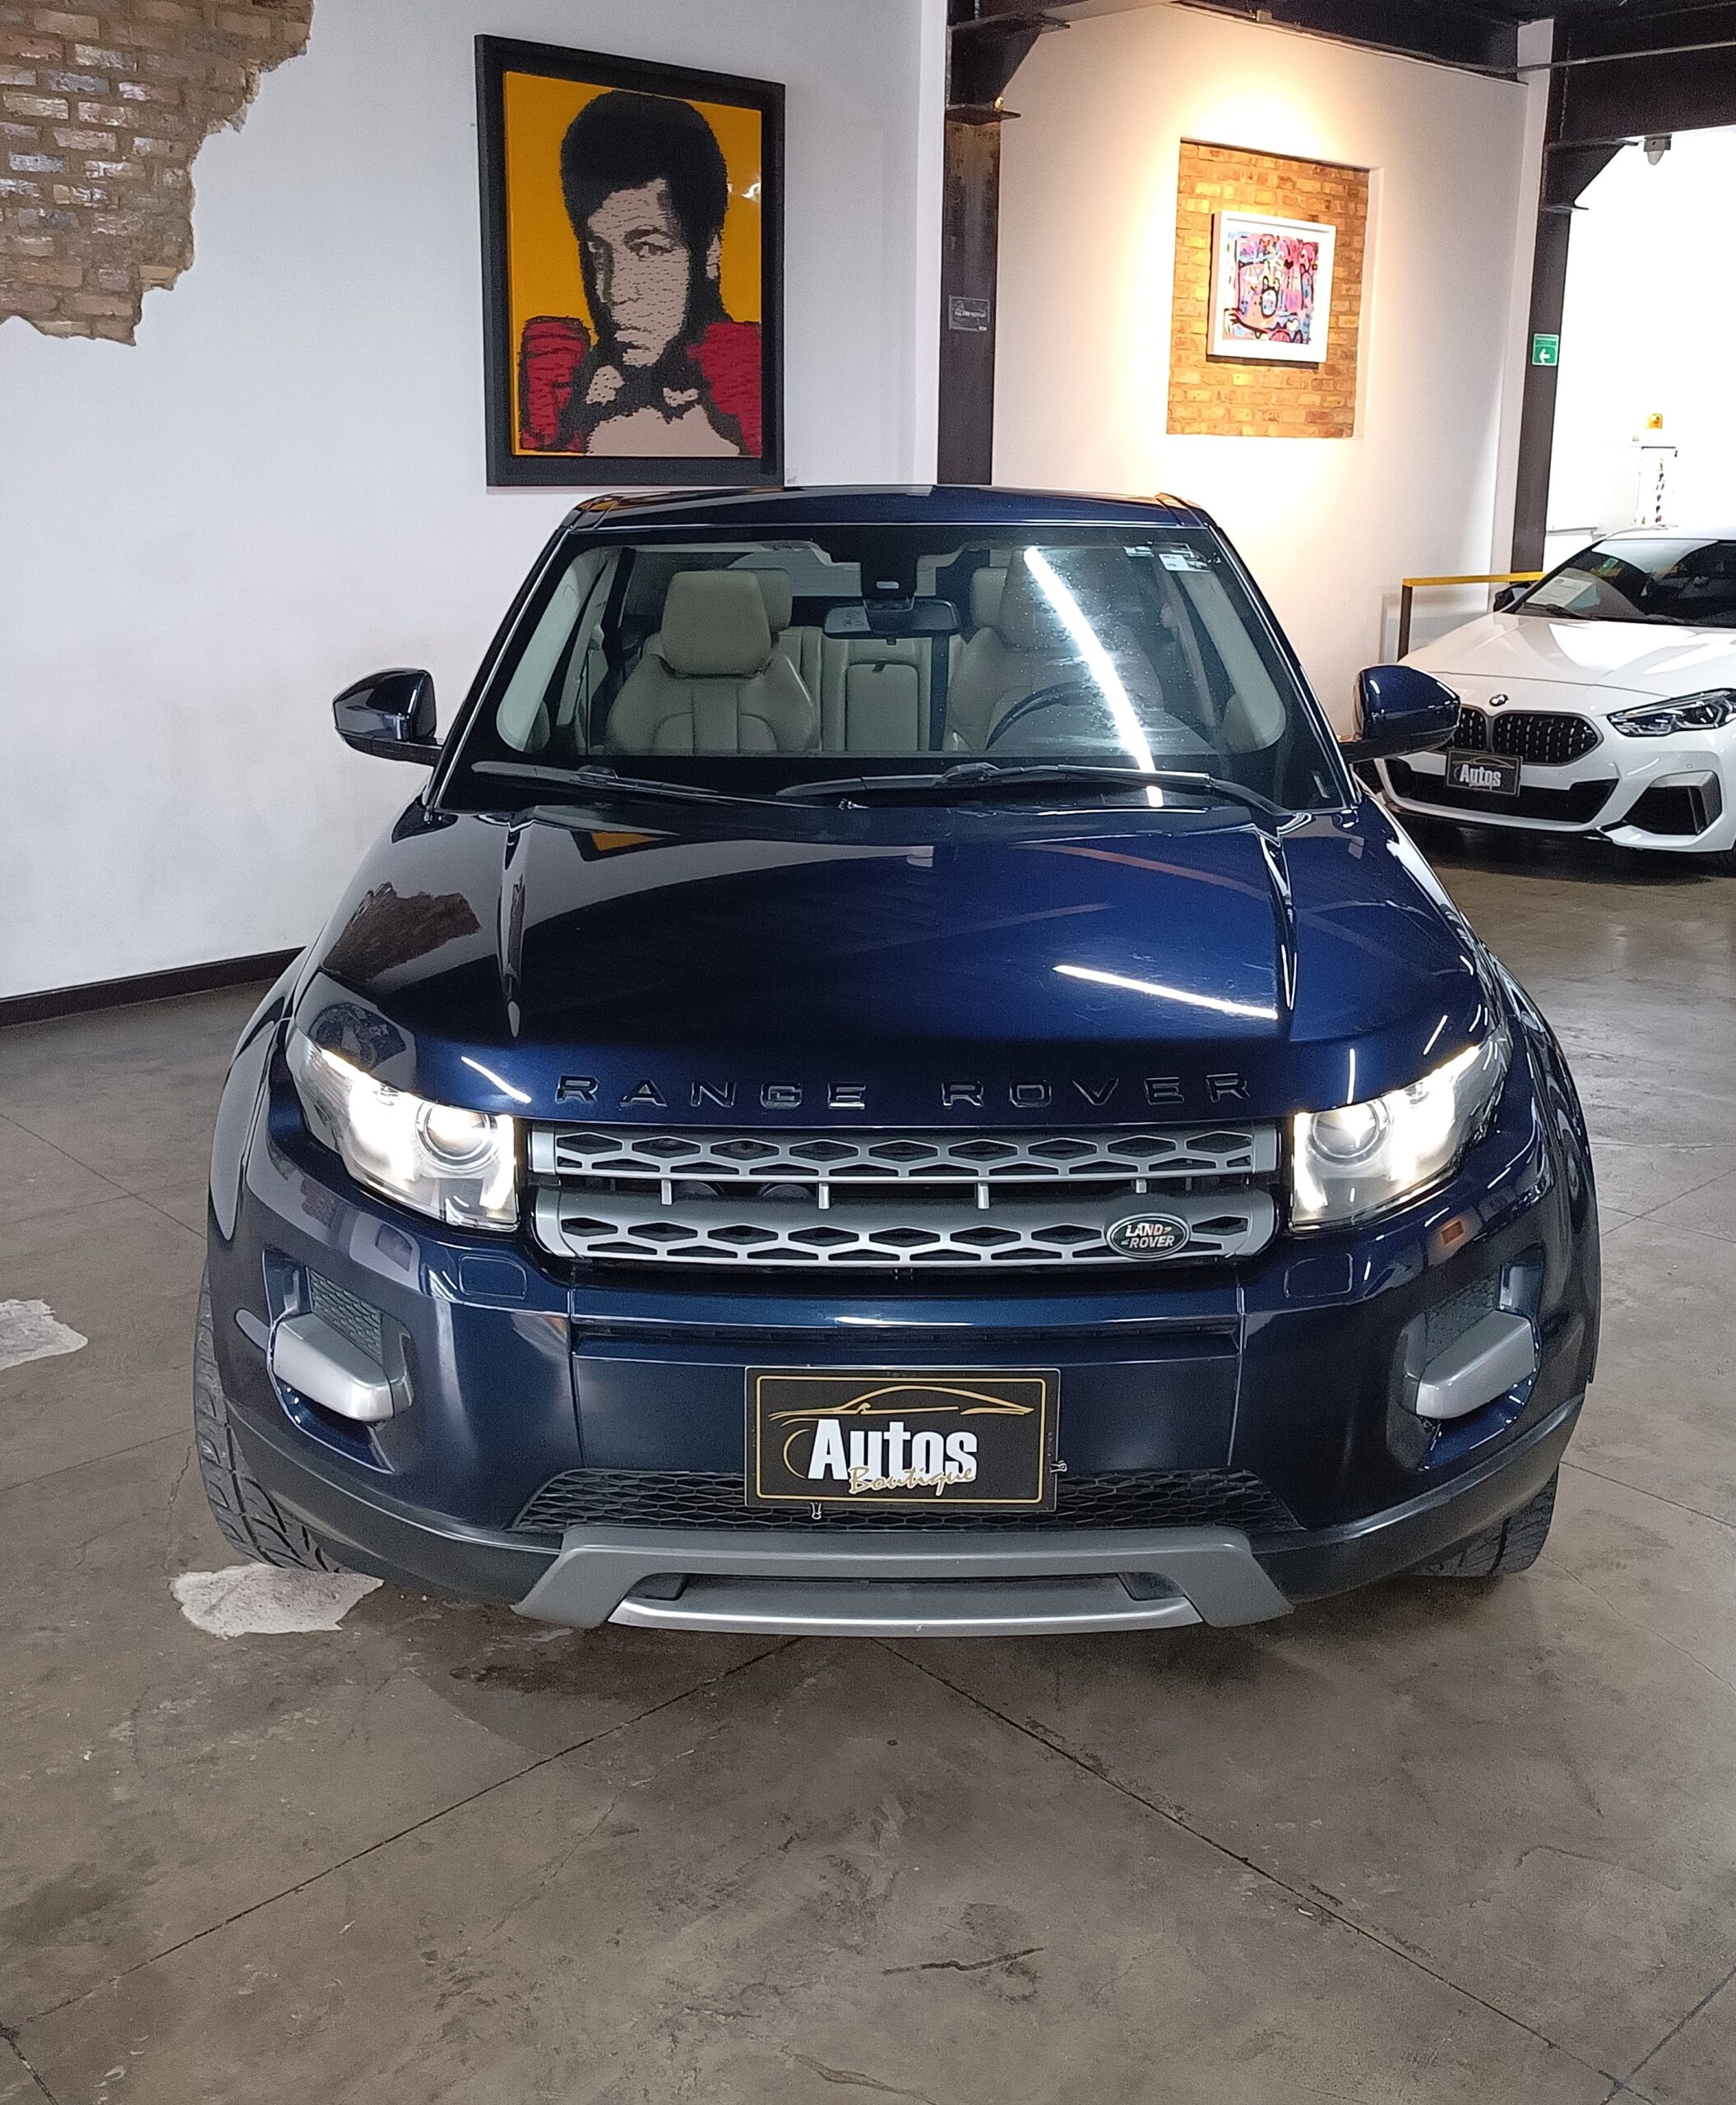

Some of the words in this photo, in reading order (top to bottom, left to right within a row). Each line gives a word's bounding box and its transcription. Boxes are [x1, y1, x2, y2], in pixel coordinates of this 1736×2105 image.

[1460, 764, 1502, 787] Autos
[555, 1075, 866, 1110] RANGE
[942, 1073, 1251, 1108] ROVER
[1125, 1223, 1164, 1237] LAND
[1129, 1235, 1174, 1248] ROVER
[808, 1418, 978, 1480] Autos
[848, 1467, 976, 1497] Boutique
